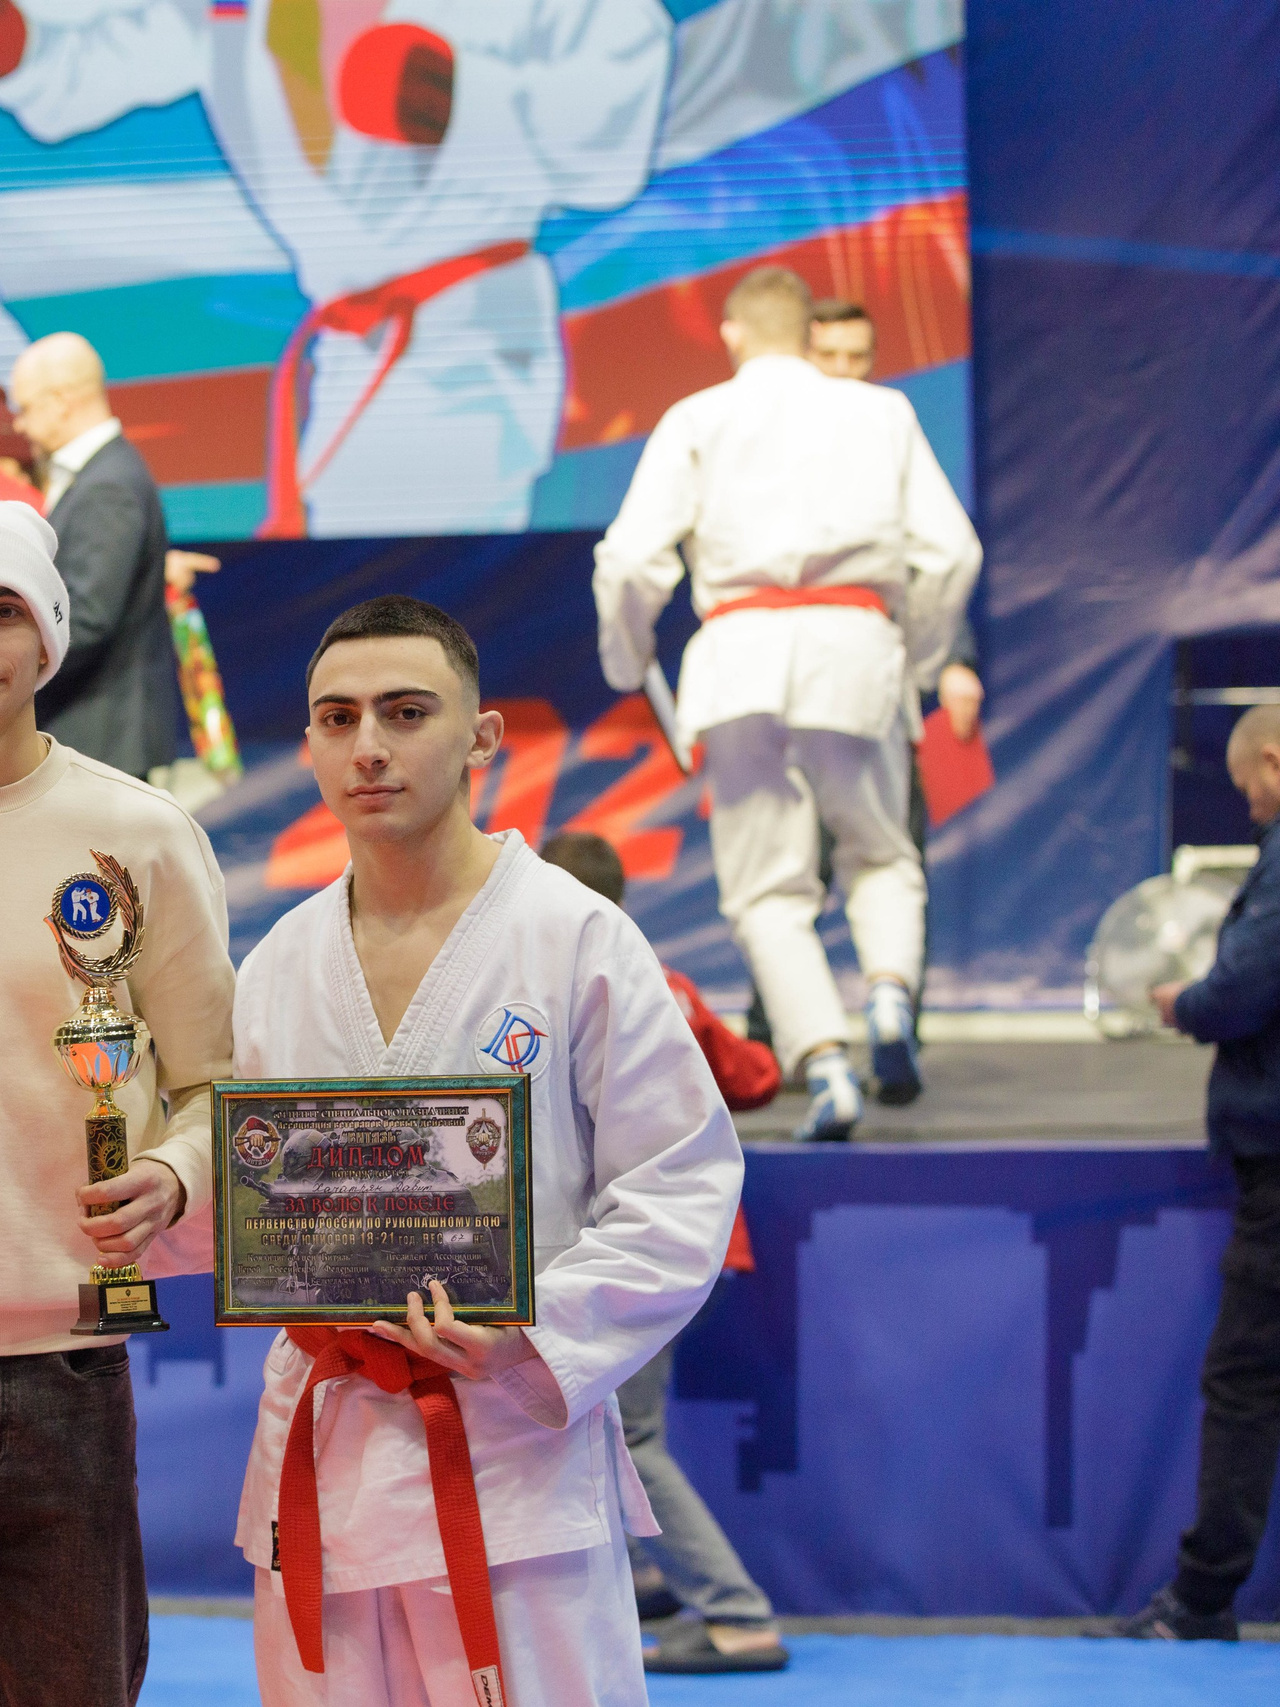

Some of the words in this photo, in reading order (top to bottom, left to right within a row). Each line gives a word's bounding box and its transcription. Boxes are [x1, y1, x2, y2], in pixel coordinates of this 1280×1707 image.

[307, 1145, 425, 1169] ДИПЛОМ
[285, 1196, 306, 1213] ЗА
[367, 1196, 379, 1214] К
[384, 1195, 455, 1213] ПОБЕДЕ
[246, 1217, 315, 1230] ПЕРВЕНСТВО
[319, 1217, 363, 1229] РОССИИ
[366, 1216, 381, 1229] ПО
[385, 1216, 472, 1229] РУКОПАШНОМУ
[475, 1215, 501, 1228] БОЮ
